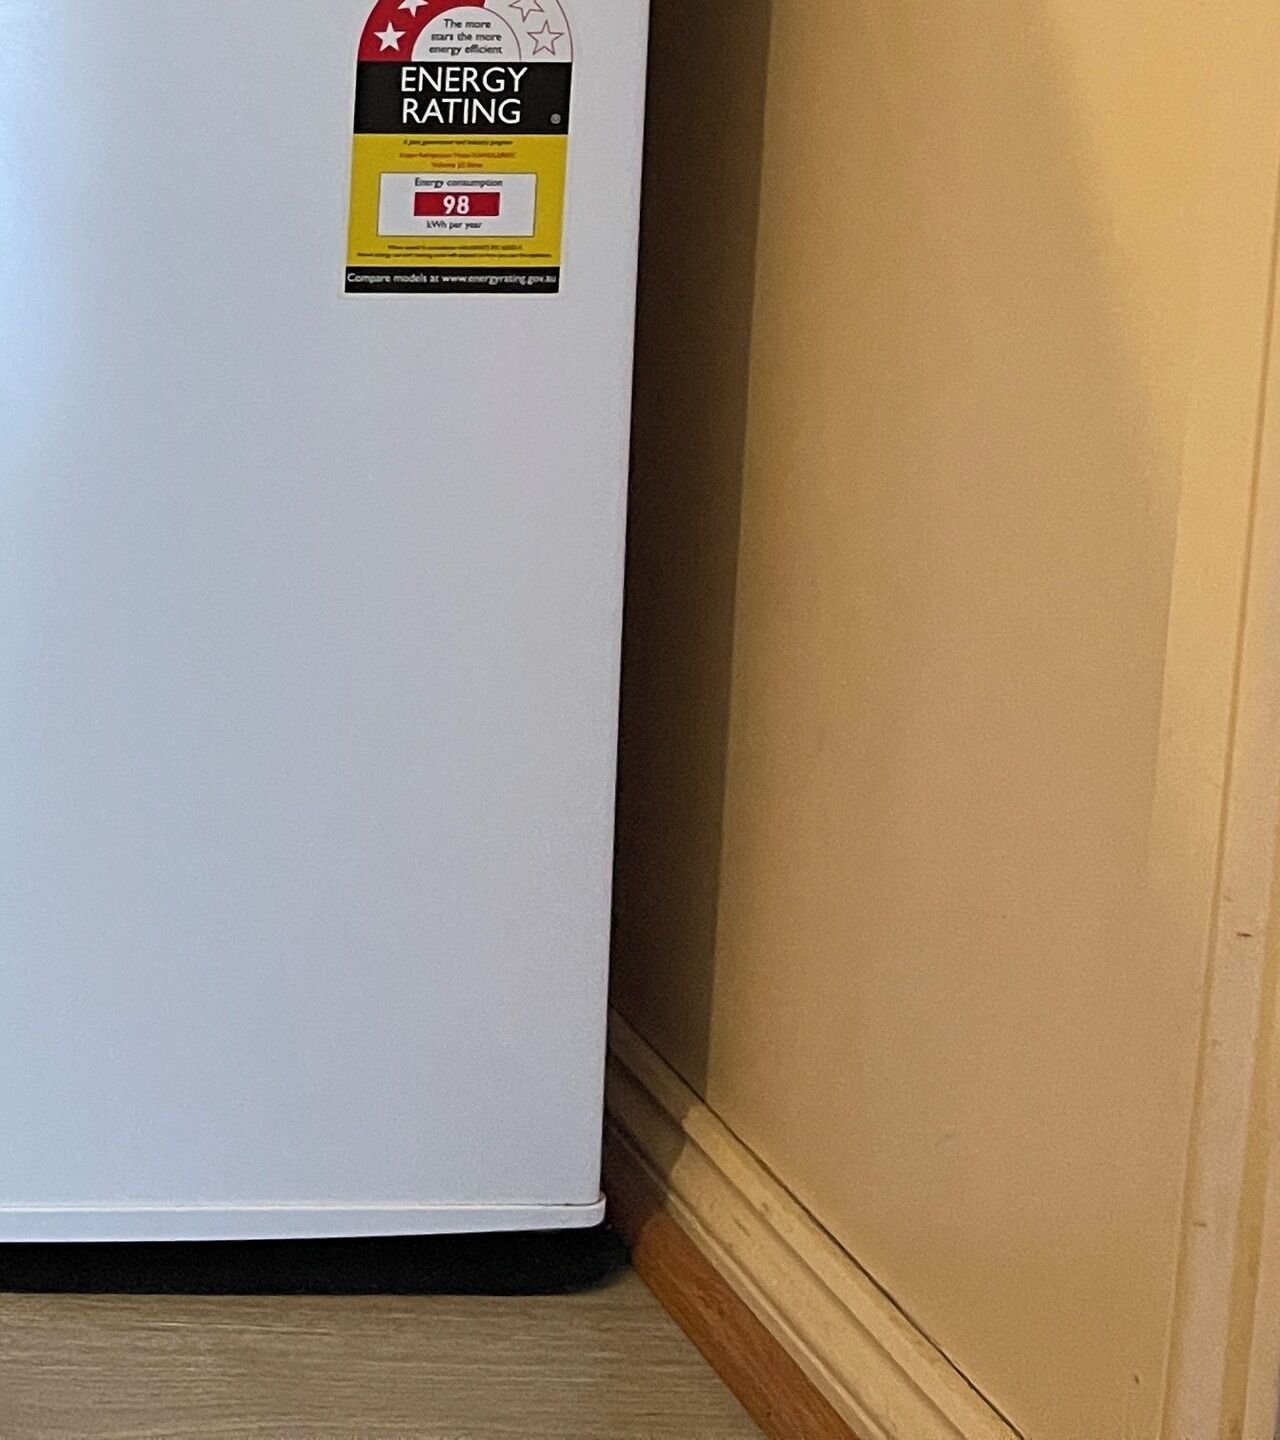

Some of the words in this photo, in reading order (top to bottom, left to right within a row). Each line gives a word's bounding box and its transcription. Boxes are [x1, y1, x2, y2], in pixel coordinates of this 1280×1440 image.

[444, 19, 462, 29] The
[465, 20, 491, 29] more
[431, 33, 454, 42] stars
[457, 32, 473, 42] the
[475, 33, 502, 42] more
[429, 46, 462, 56] energy
[465, 45, 503, 54] efficient
[401, 66, 528, 92] ENERGY
[402, 98, 521, 124] RATING
[414, 177, 444, 188] Energy
[446, 178, 503, 188] consumption
[442, 195, 470, 215] 98
[426, 220, 448, 229] kWh
[449, 221, 463, 230] per
[465, 221, 483, 230] year
[347, 272, 391, 284] Compare
[393, 273, 427, 283] models
[429, 274, 440, 283] at
[441, 273, 557, 286] www.energyrating.gov.au
